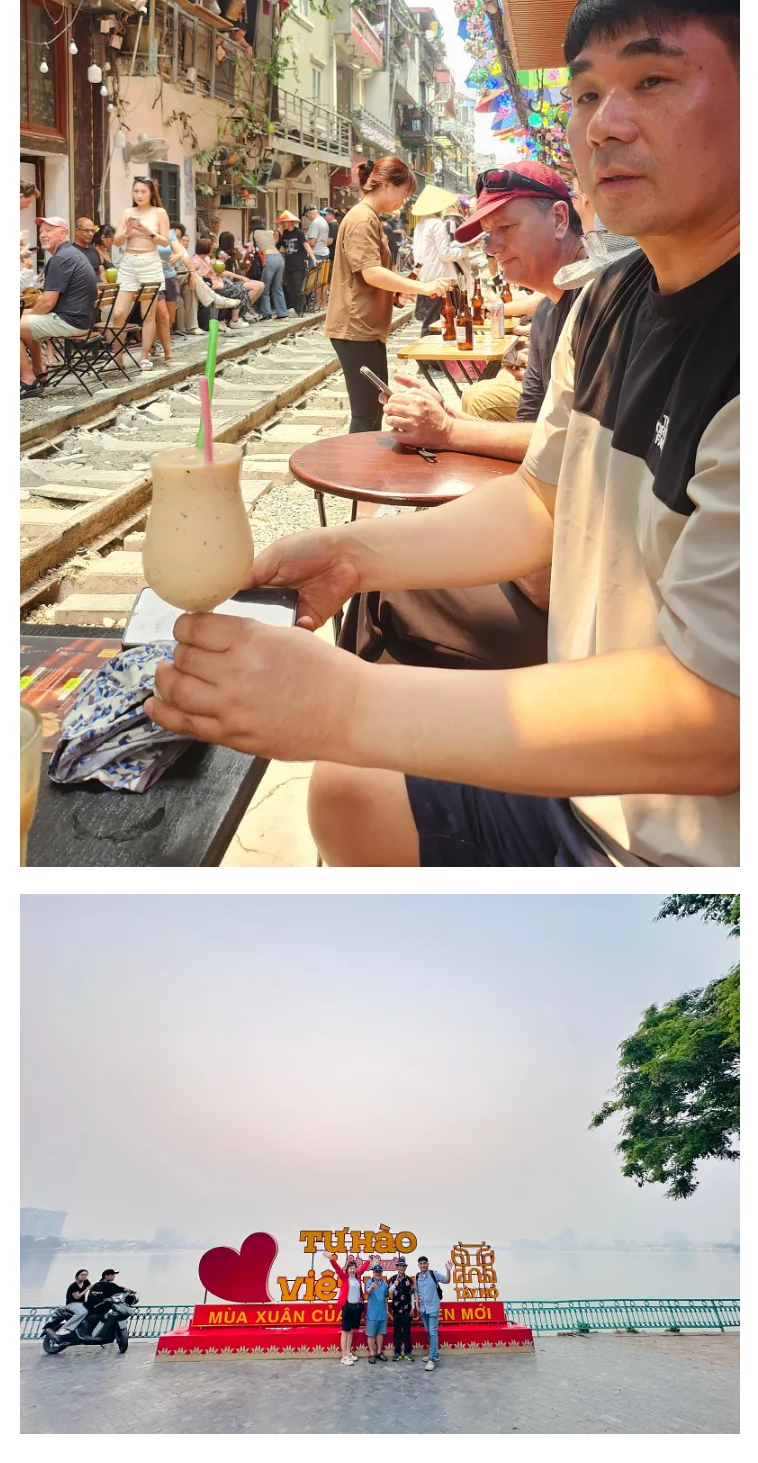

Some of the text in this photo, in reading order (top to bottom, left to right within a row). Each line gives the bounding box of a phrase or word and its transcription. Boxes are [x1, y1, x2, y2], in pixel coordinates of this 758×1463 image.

[208, 1307, 248, 1324] MÙA
[256, 1307, 305, 1324] XUÂN
[461, 1303, 492, 1320] MỚI
